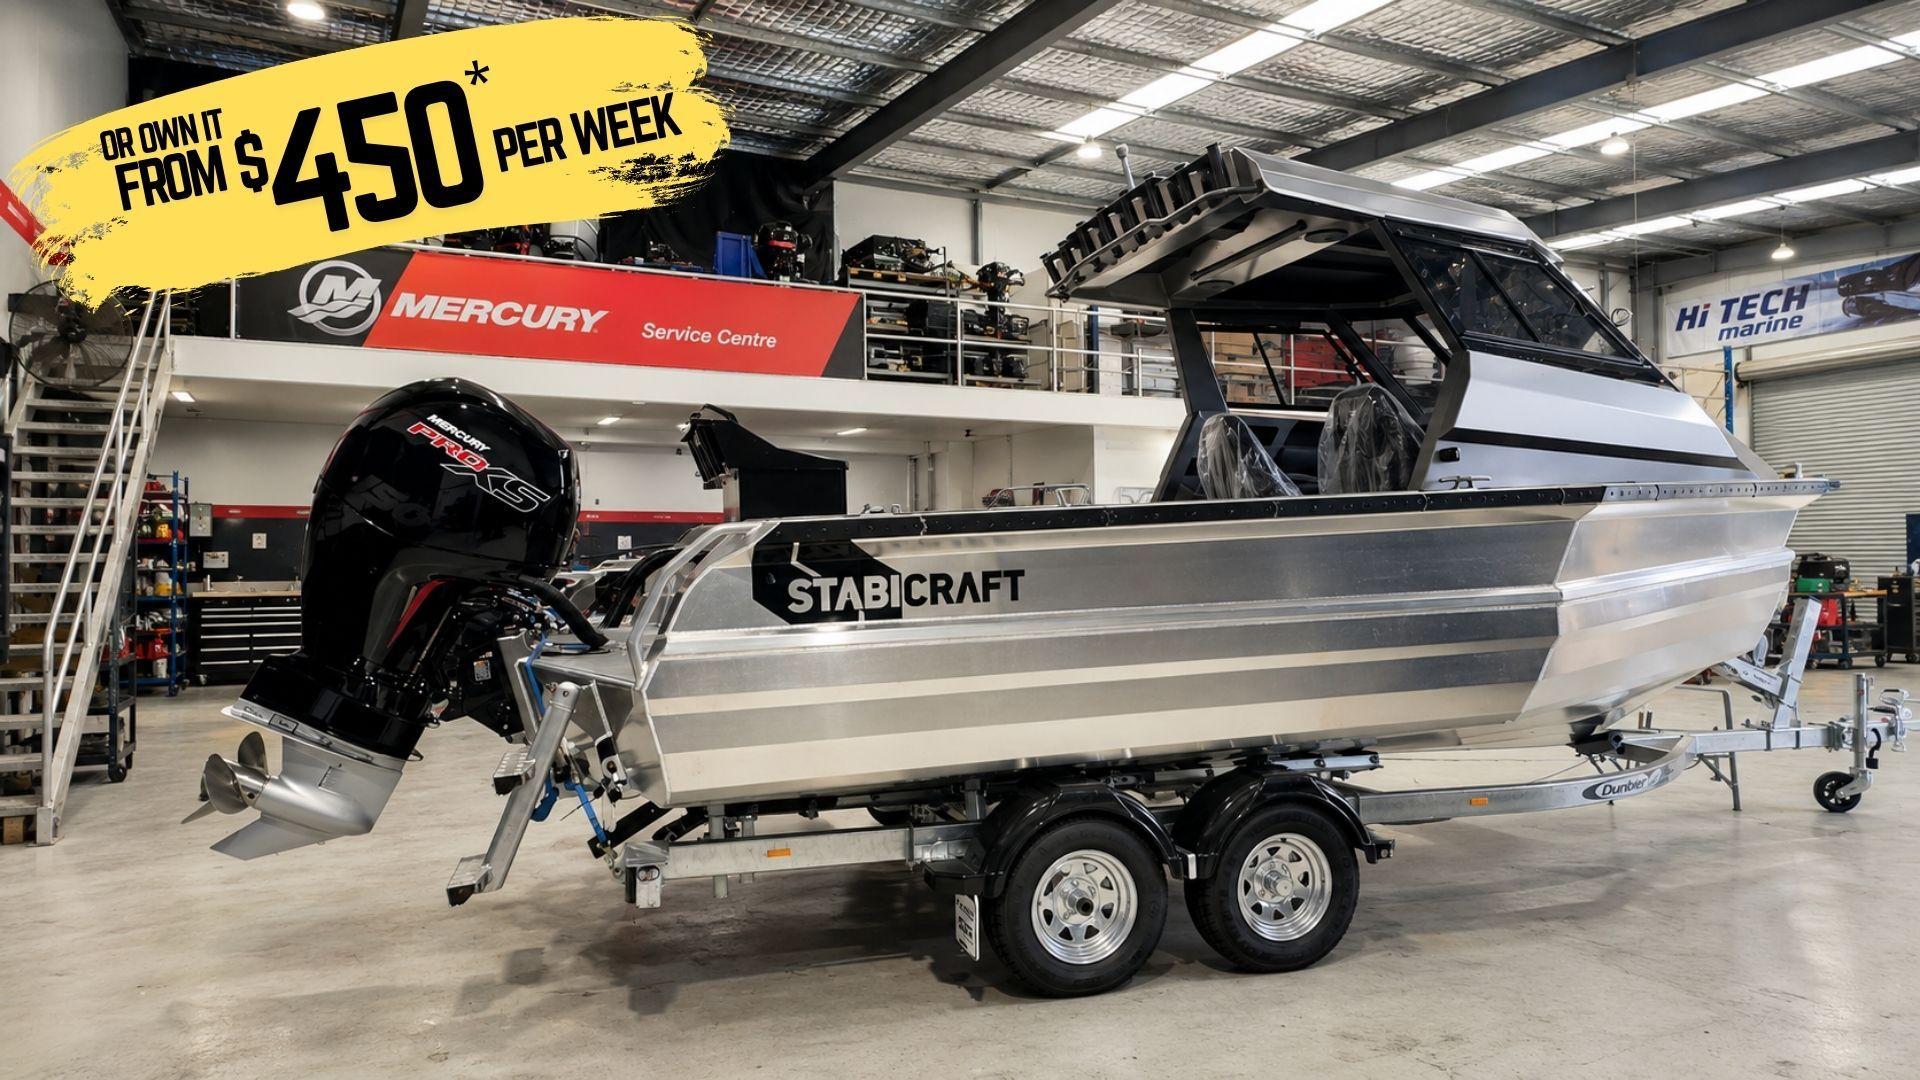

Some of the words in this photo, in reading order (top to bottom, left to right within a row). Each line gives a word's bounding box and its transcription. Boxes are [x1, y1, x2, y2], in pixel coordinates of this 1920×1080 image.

[390, 292, 609, 334] MERCURY
[641, 322, 712, 344] Service
[717, 329, 777, 349] Centre
[1675, 303, 1711, 332] Hi
[1720, 283, 1810, 324] TECH
[1718, 314, 1803, 341] marine
[406, 421, 490, 473] PRO
[426, 413, 491, 452] MERCURY
[439, 463, 551, 513] XS
[787, 569, 1025, 614] STABICRAFT
[1601, 778, 1647, 796] Dunbier
